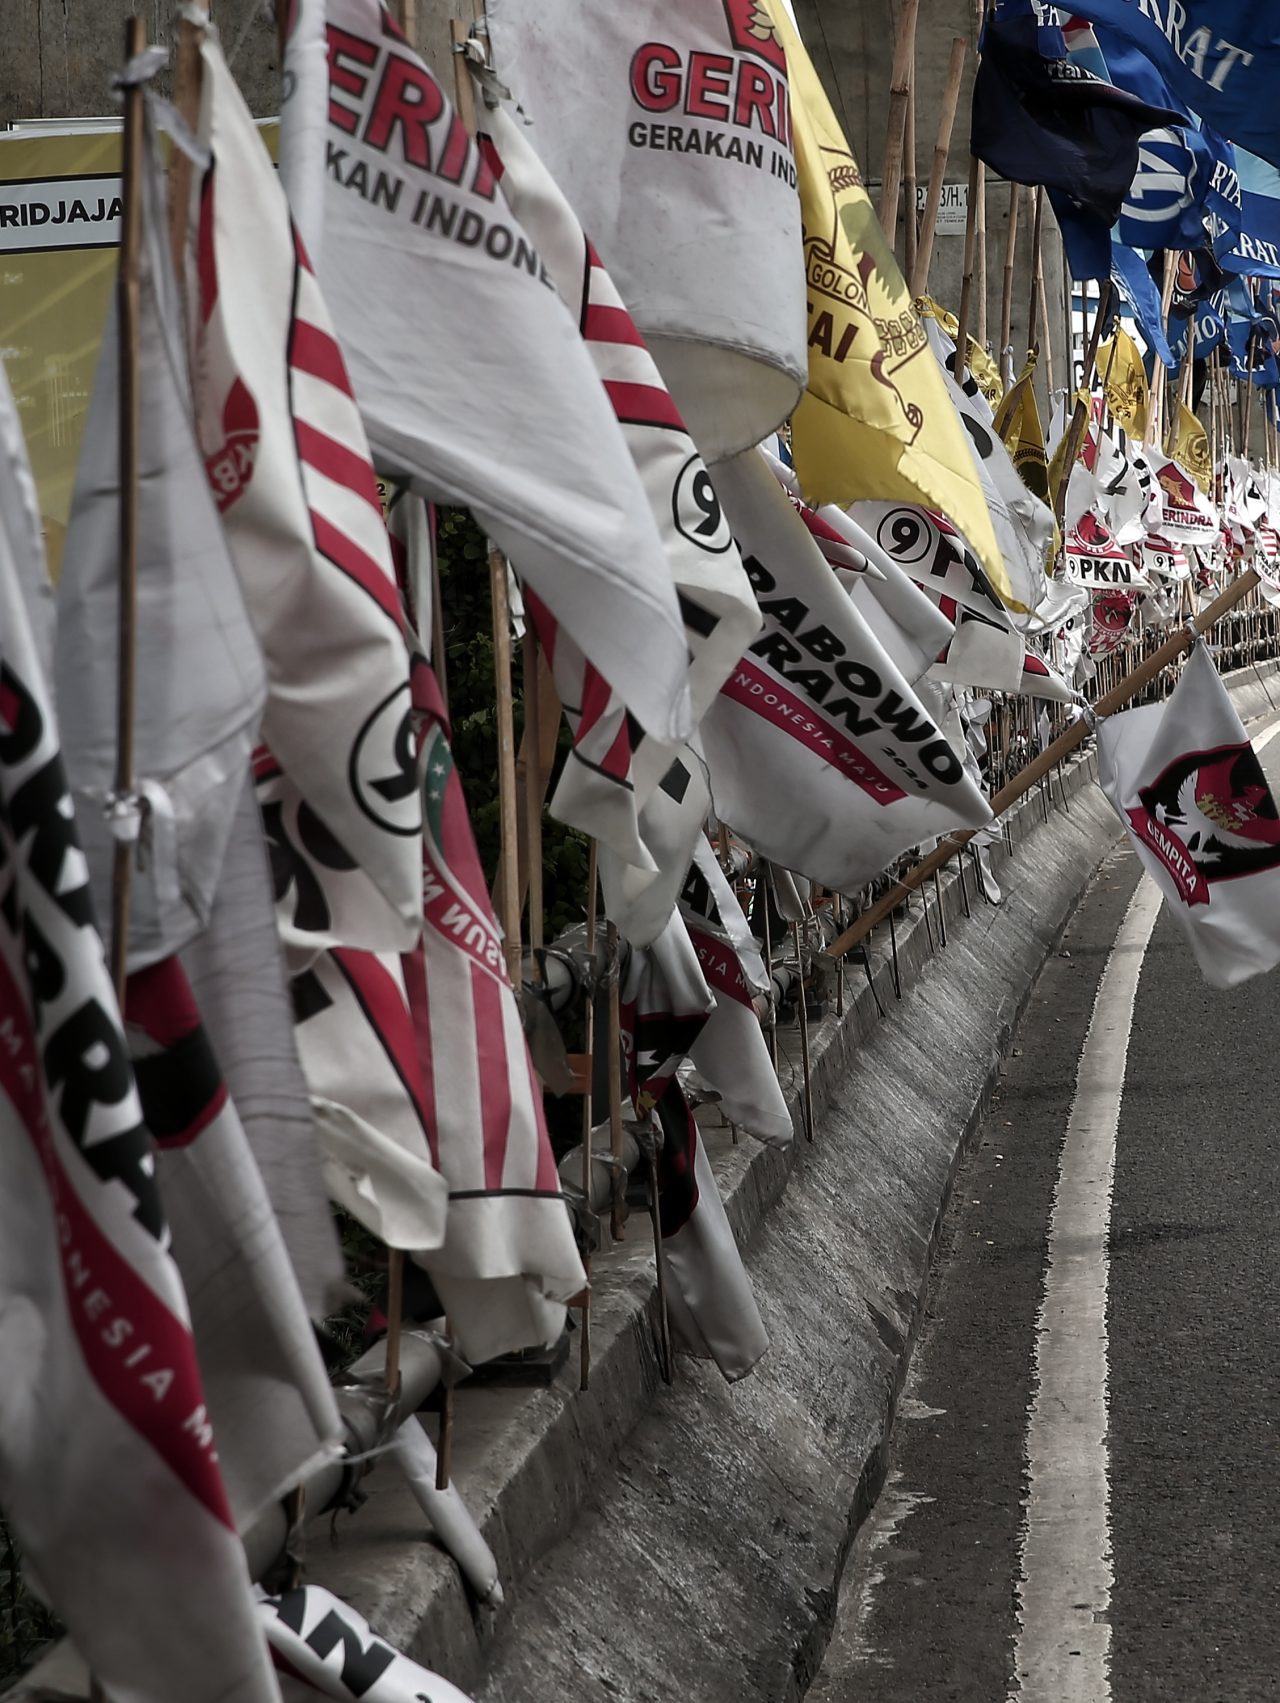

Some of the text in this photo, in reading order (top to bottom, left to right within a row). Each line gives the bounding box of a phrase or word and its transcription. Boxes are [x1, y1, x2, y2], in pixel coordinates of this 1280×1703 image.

[629, 41, 792, 152] GERI
[628, 121, 764, 169] GERAKAN
[1228, 232, 1280, 268] RAT
[807, 302, 860, 363] AI
[888, 517, 920, 555] 9
[1080, 559, 1132, 583] PKN
[735, 538, 963, 785] RABOWO
[748, 624, 883, 738] RAN
[734, 669, 889, 794] NDONESIA MAJU
[881, 745, 929, 791] 2024
[695, 944, 728, 976] SIA
